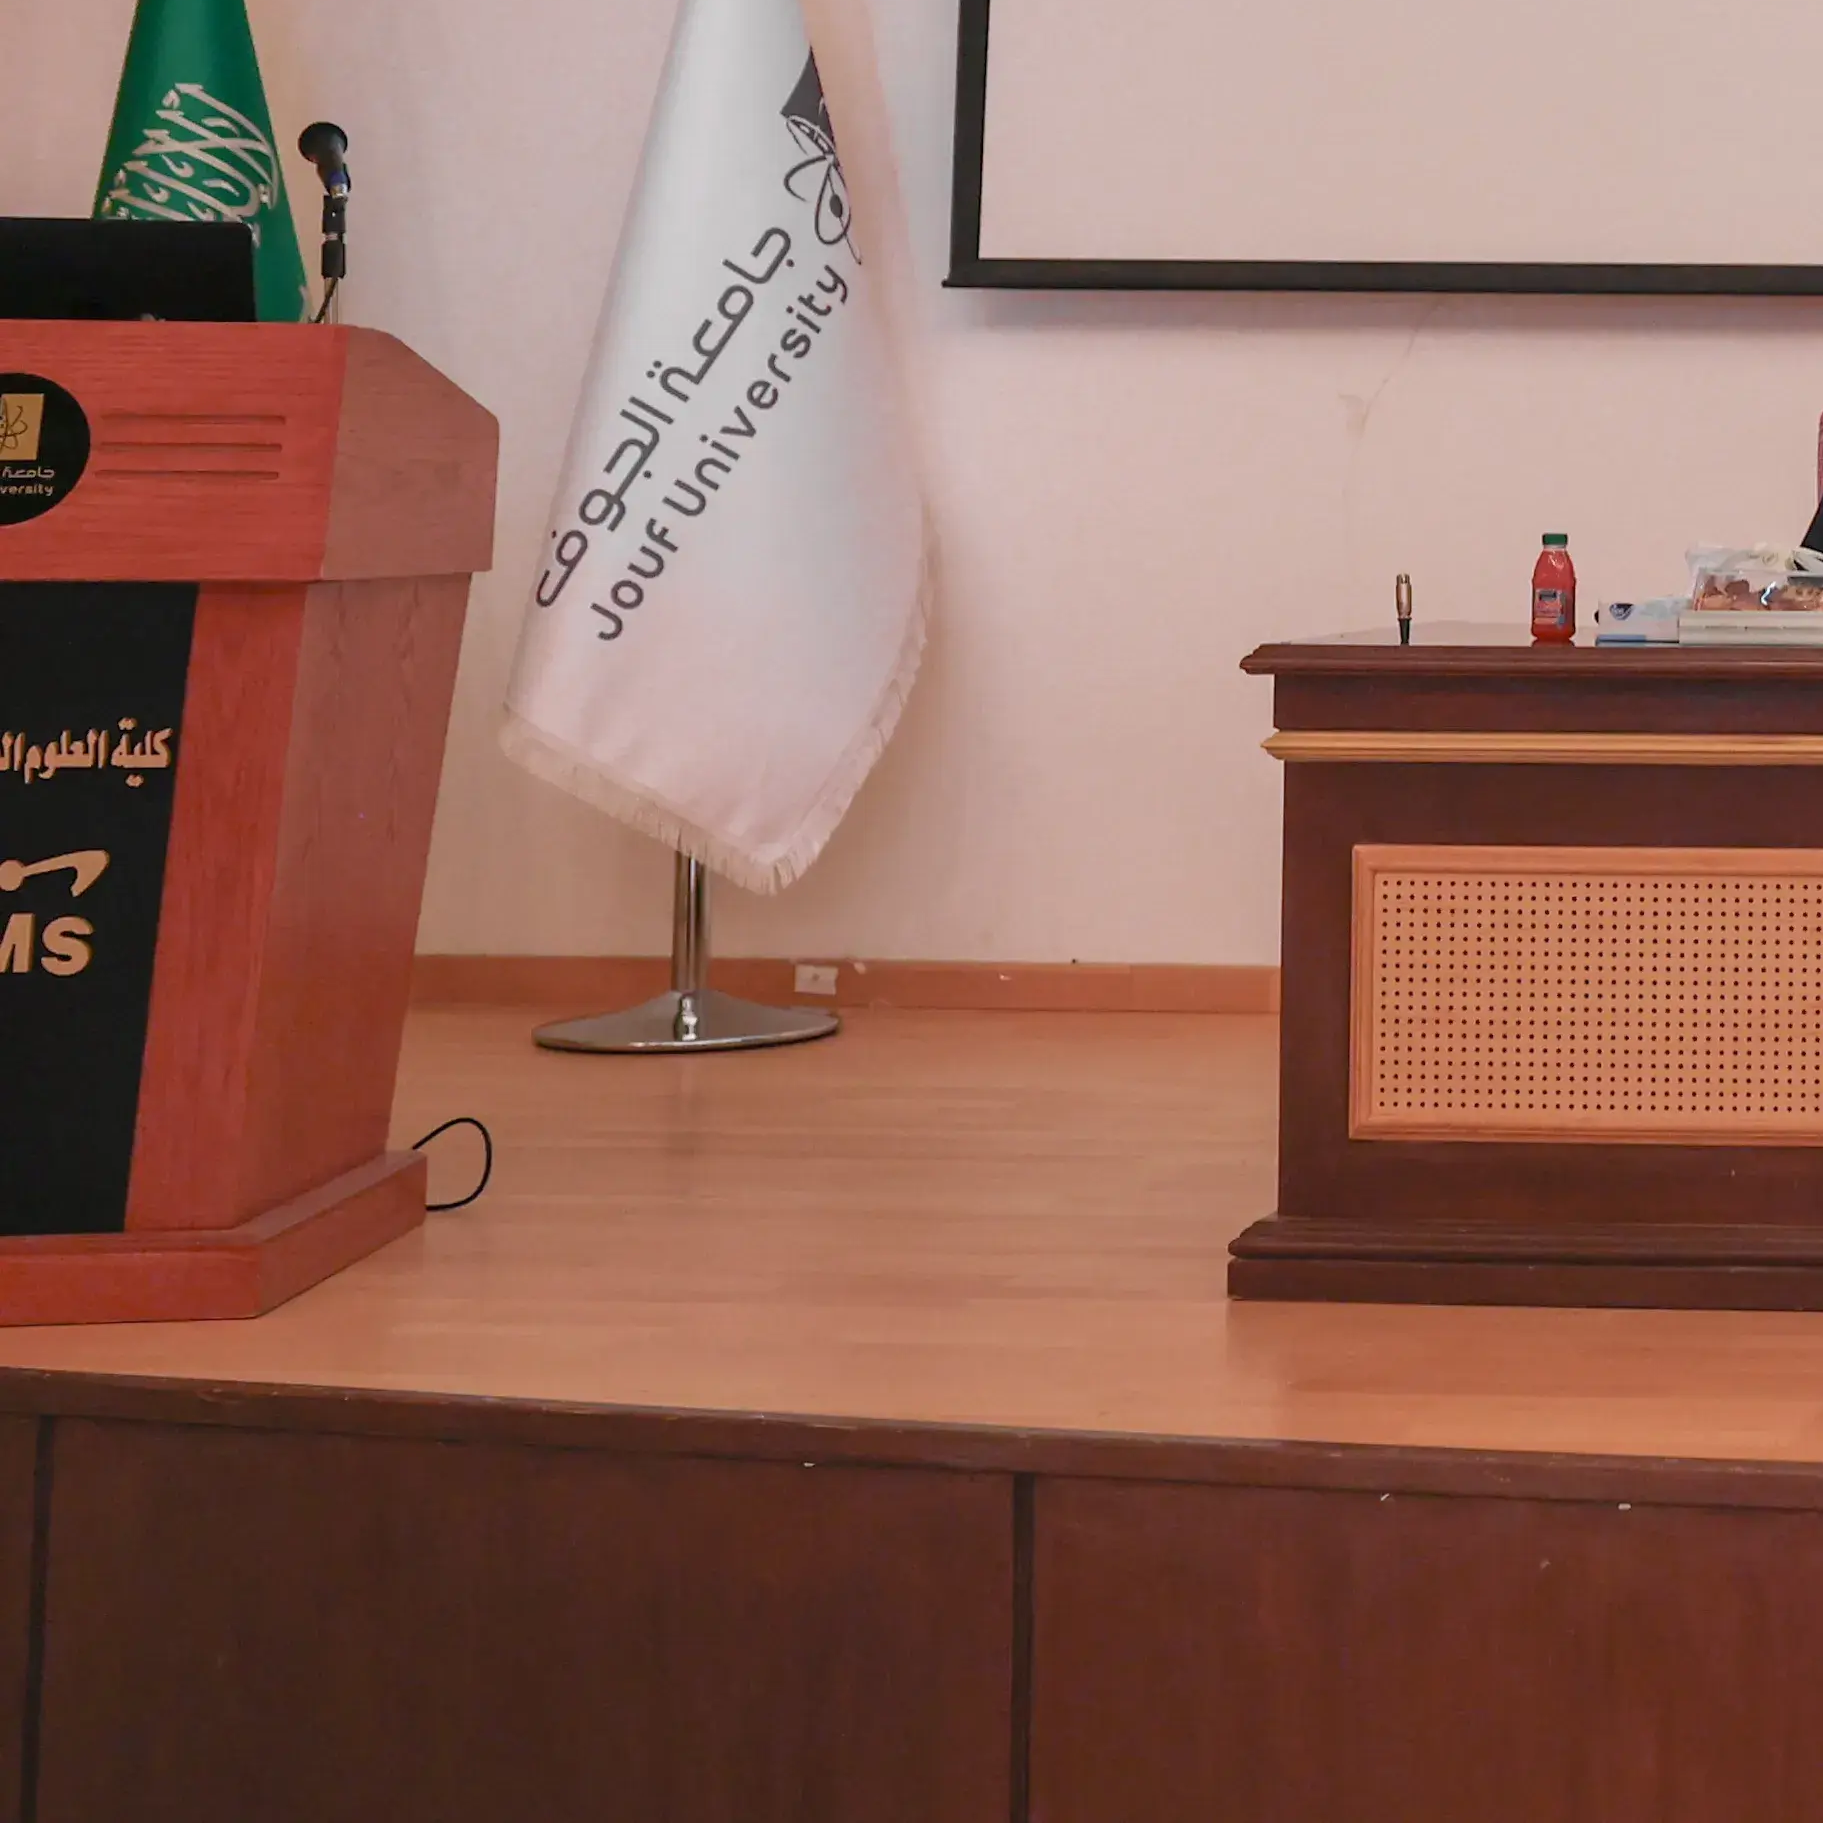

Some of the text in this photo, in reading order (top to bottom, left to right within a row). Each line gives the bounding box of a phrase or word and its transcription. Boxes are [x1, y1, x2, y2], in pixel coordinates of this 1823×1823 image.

[535, 228, 797, 610] جامعة الجوف
[662, 264, 850, 518] University
[0, 483, 54, 497] versity
[24, 728, 109, 785] العلوم
[111, 716, 173, 788] كلية
[0, 912, 95, 977] MS
